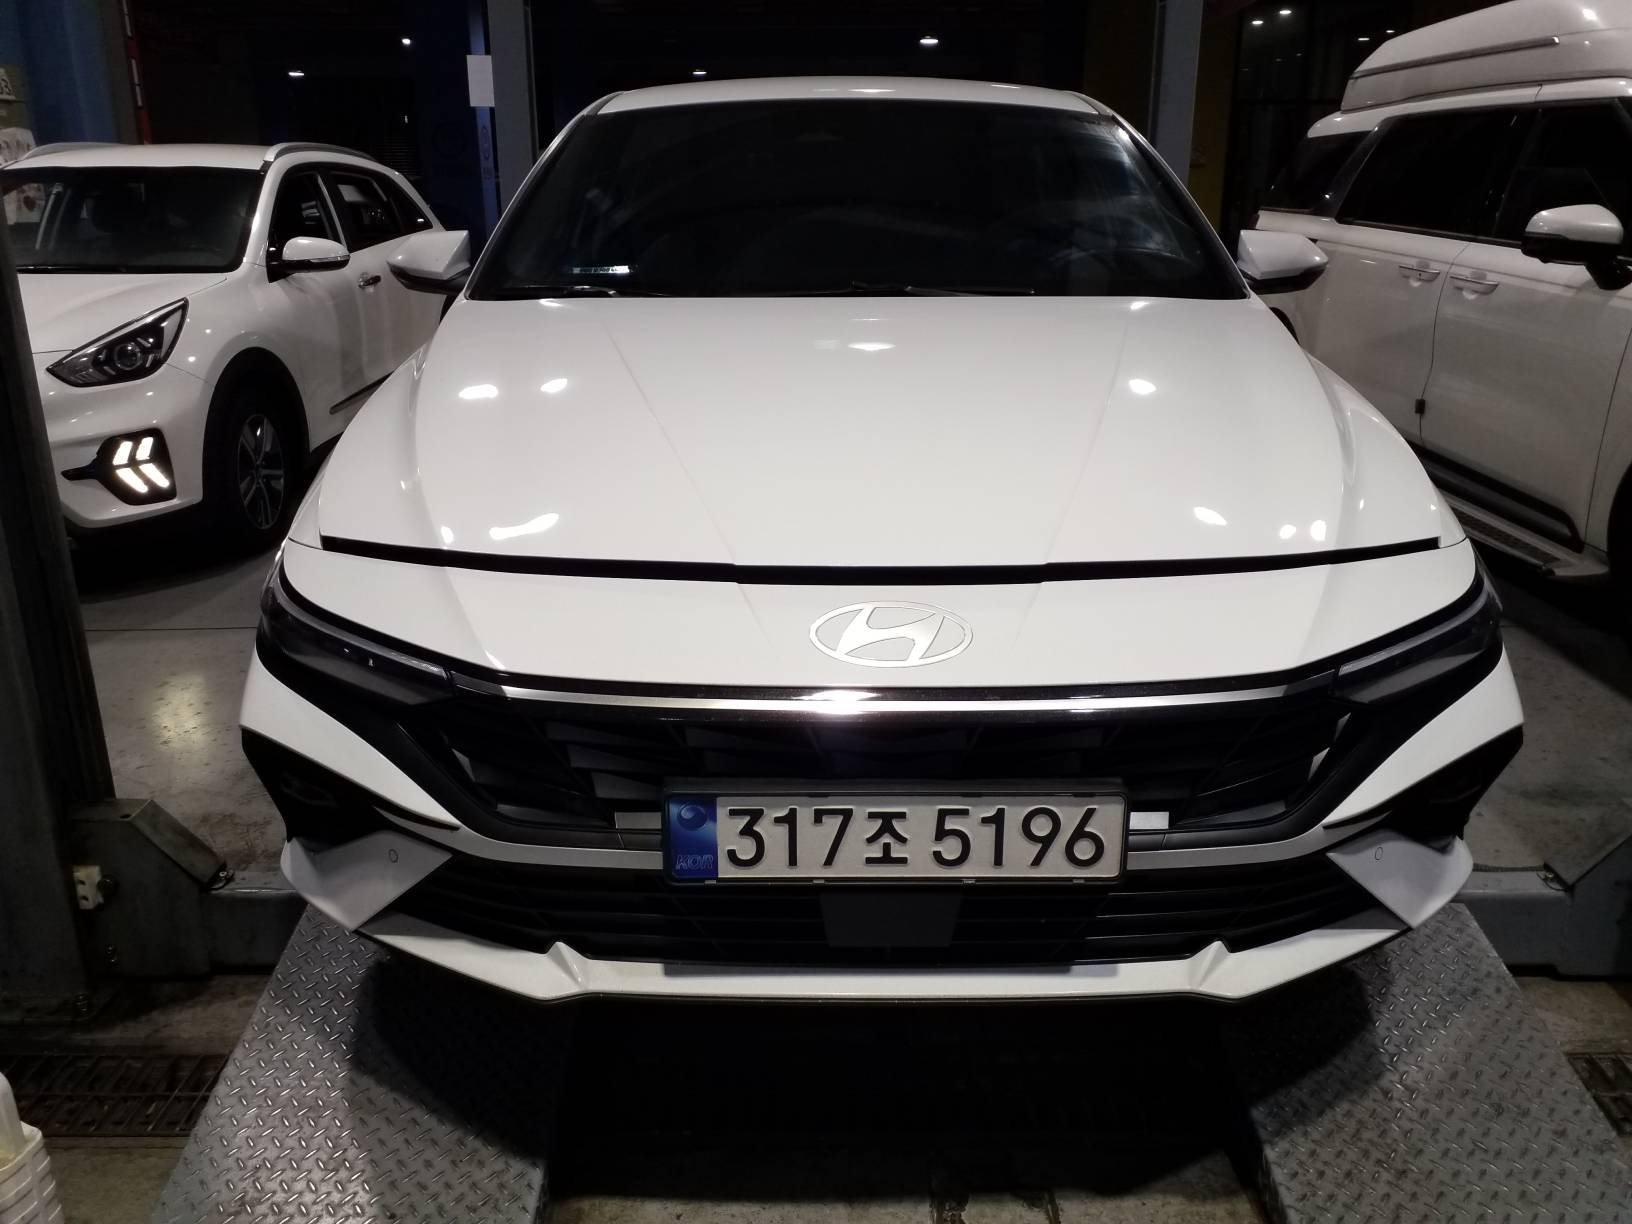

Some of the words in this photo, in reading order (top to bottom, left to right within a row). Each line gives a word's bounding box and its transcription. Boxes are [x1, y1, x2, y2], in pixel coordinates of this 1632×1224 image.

[726, 806, 909, 868] 317조
[931, 806, 1106, 868] 5196
[675, 854, 714, 872] KOR
